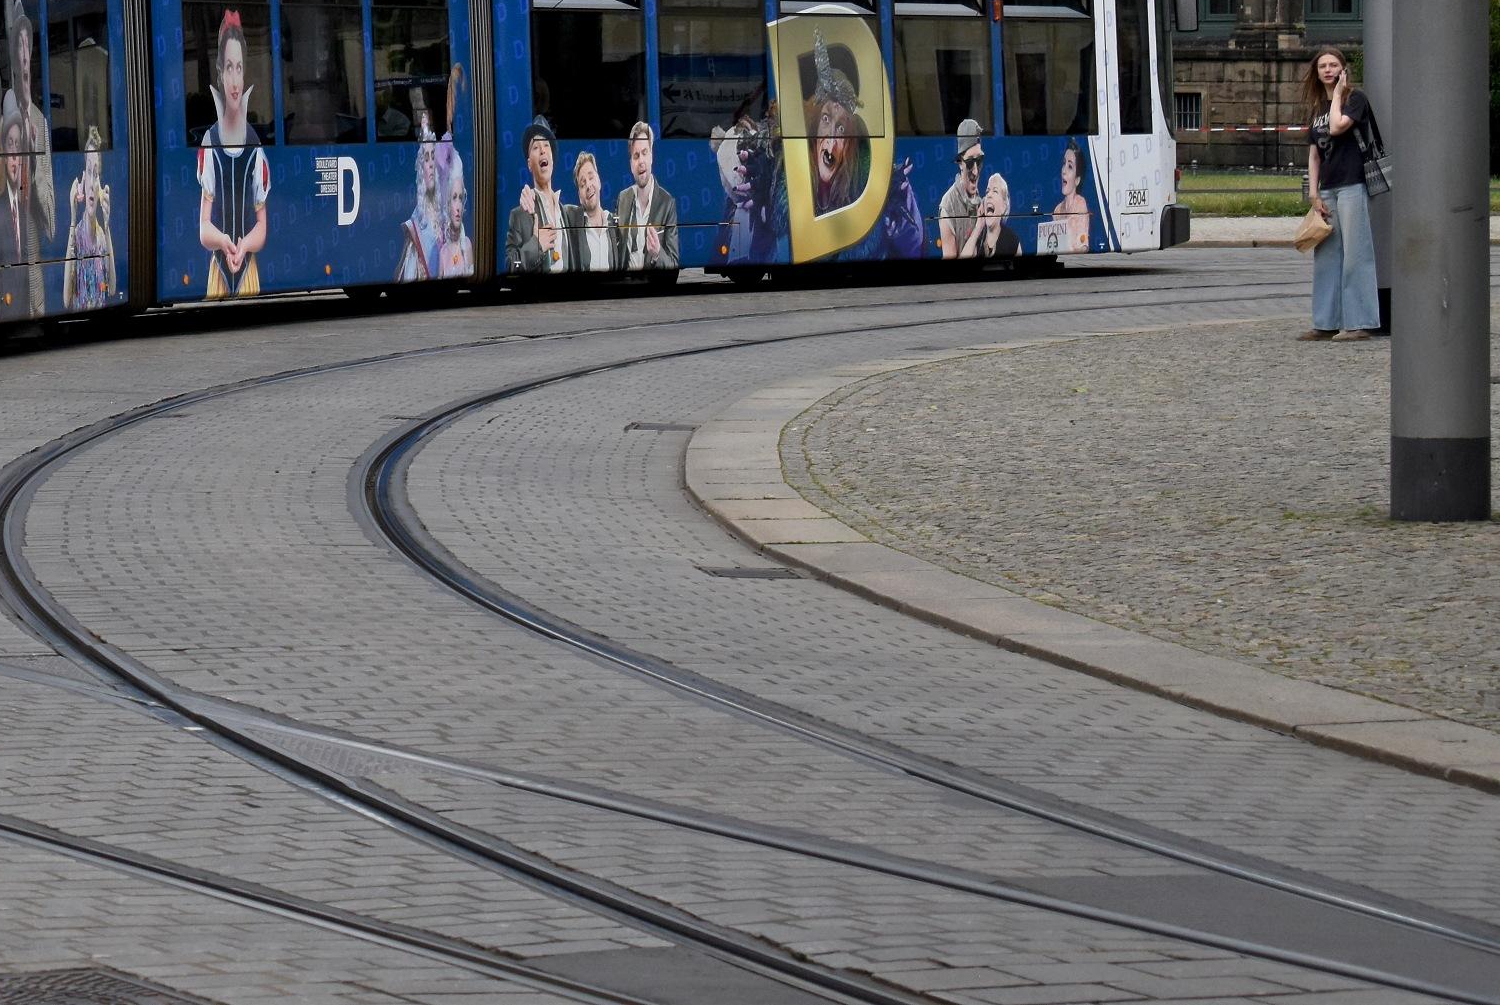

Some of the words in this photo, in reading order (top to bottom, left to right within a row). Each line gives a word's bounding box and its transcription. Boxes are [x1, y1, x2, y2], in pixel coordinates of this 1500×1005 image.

[316, 160, 337, 169] BOULEVARD
[321, 171, 337, 181] THEATER
[320, 184, 337, 193] DRESDEN
[1128, 190, 1146, 206] 2604
